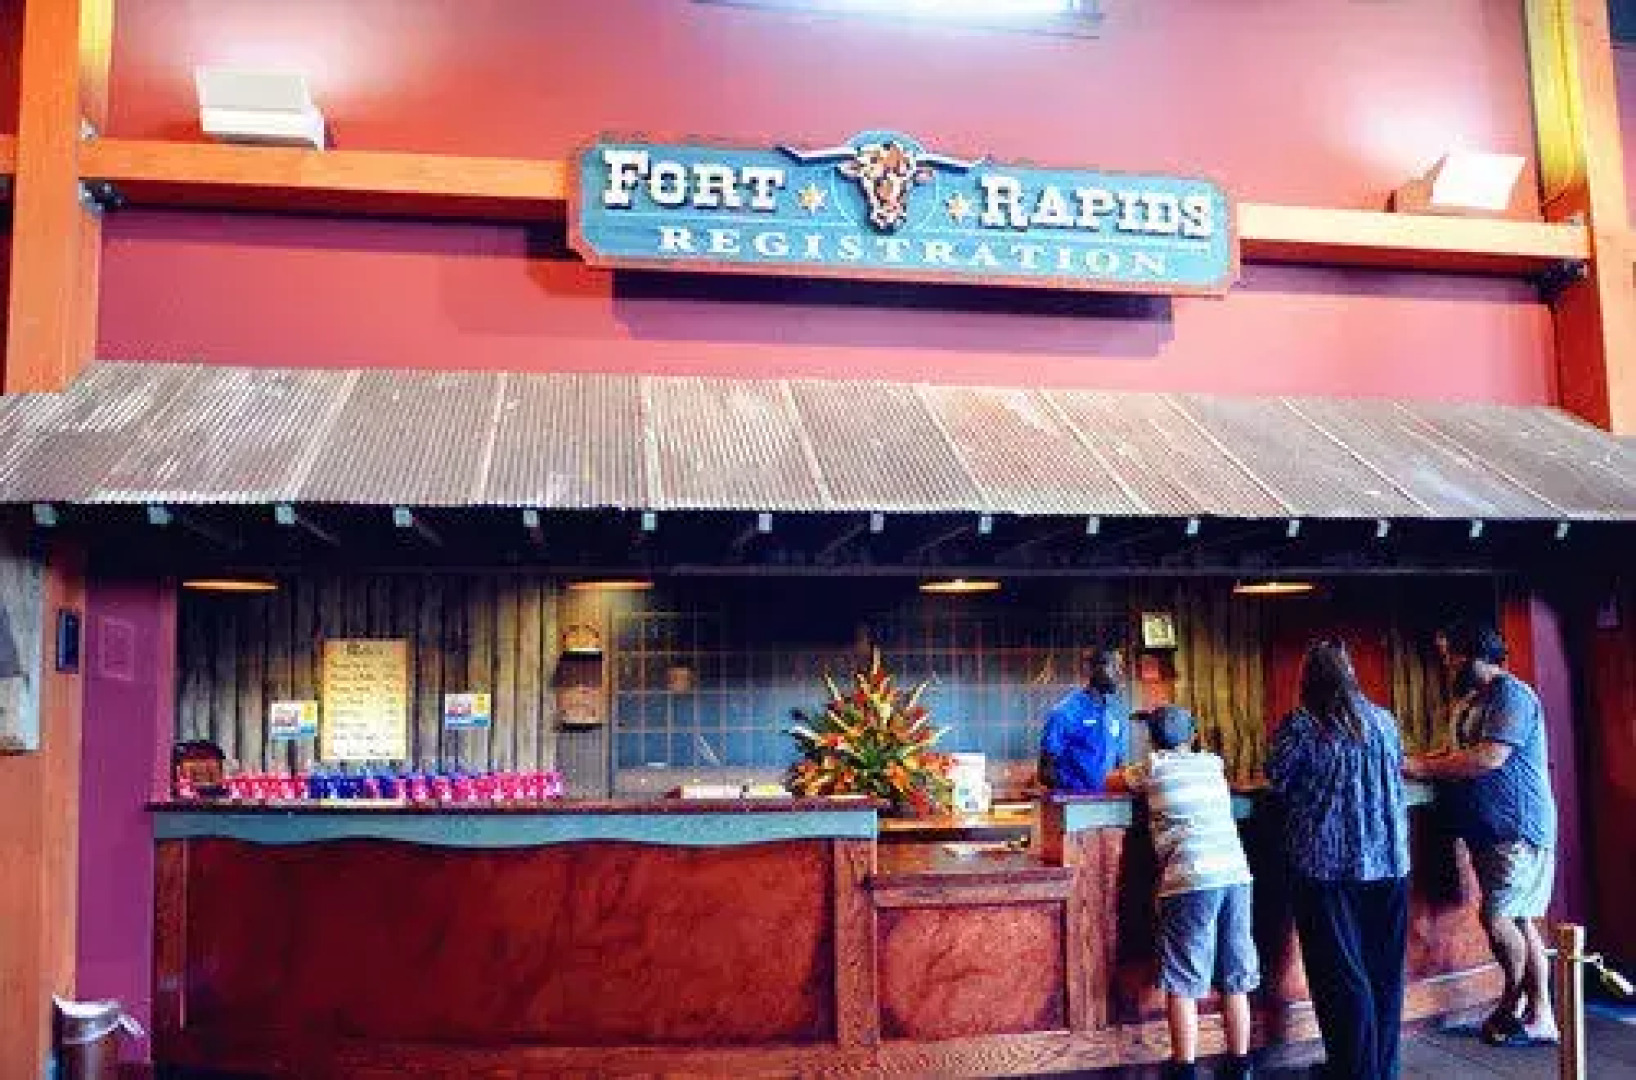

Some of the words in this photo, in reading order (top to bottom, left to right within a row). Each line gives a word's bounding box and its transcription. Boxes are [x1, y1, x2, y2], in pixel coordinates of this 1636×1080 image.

[602, 149, 785, 211] FORT
[979, 174, 1212, 238] RAPIDS
[660, 227, 1167, 276] REGISTRATION
